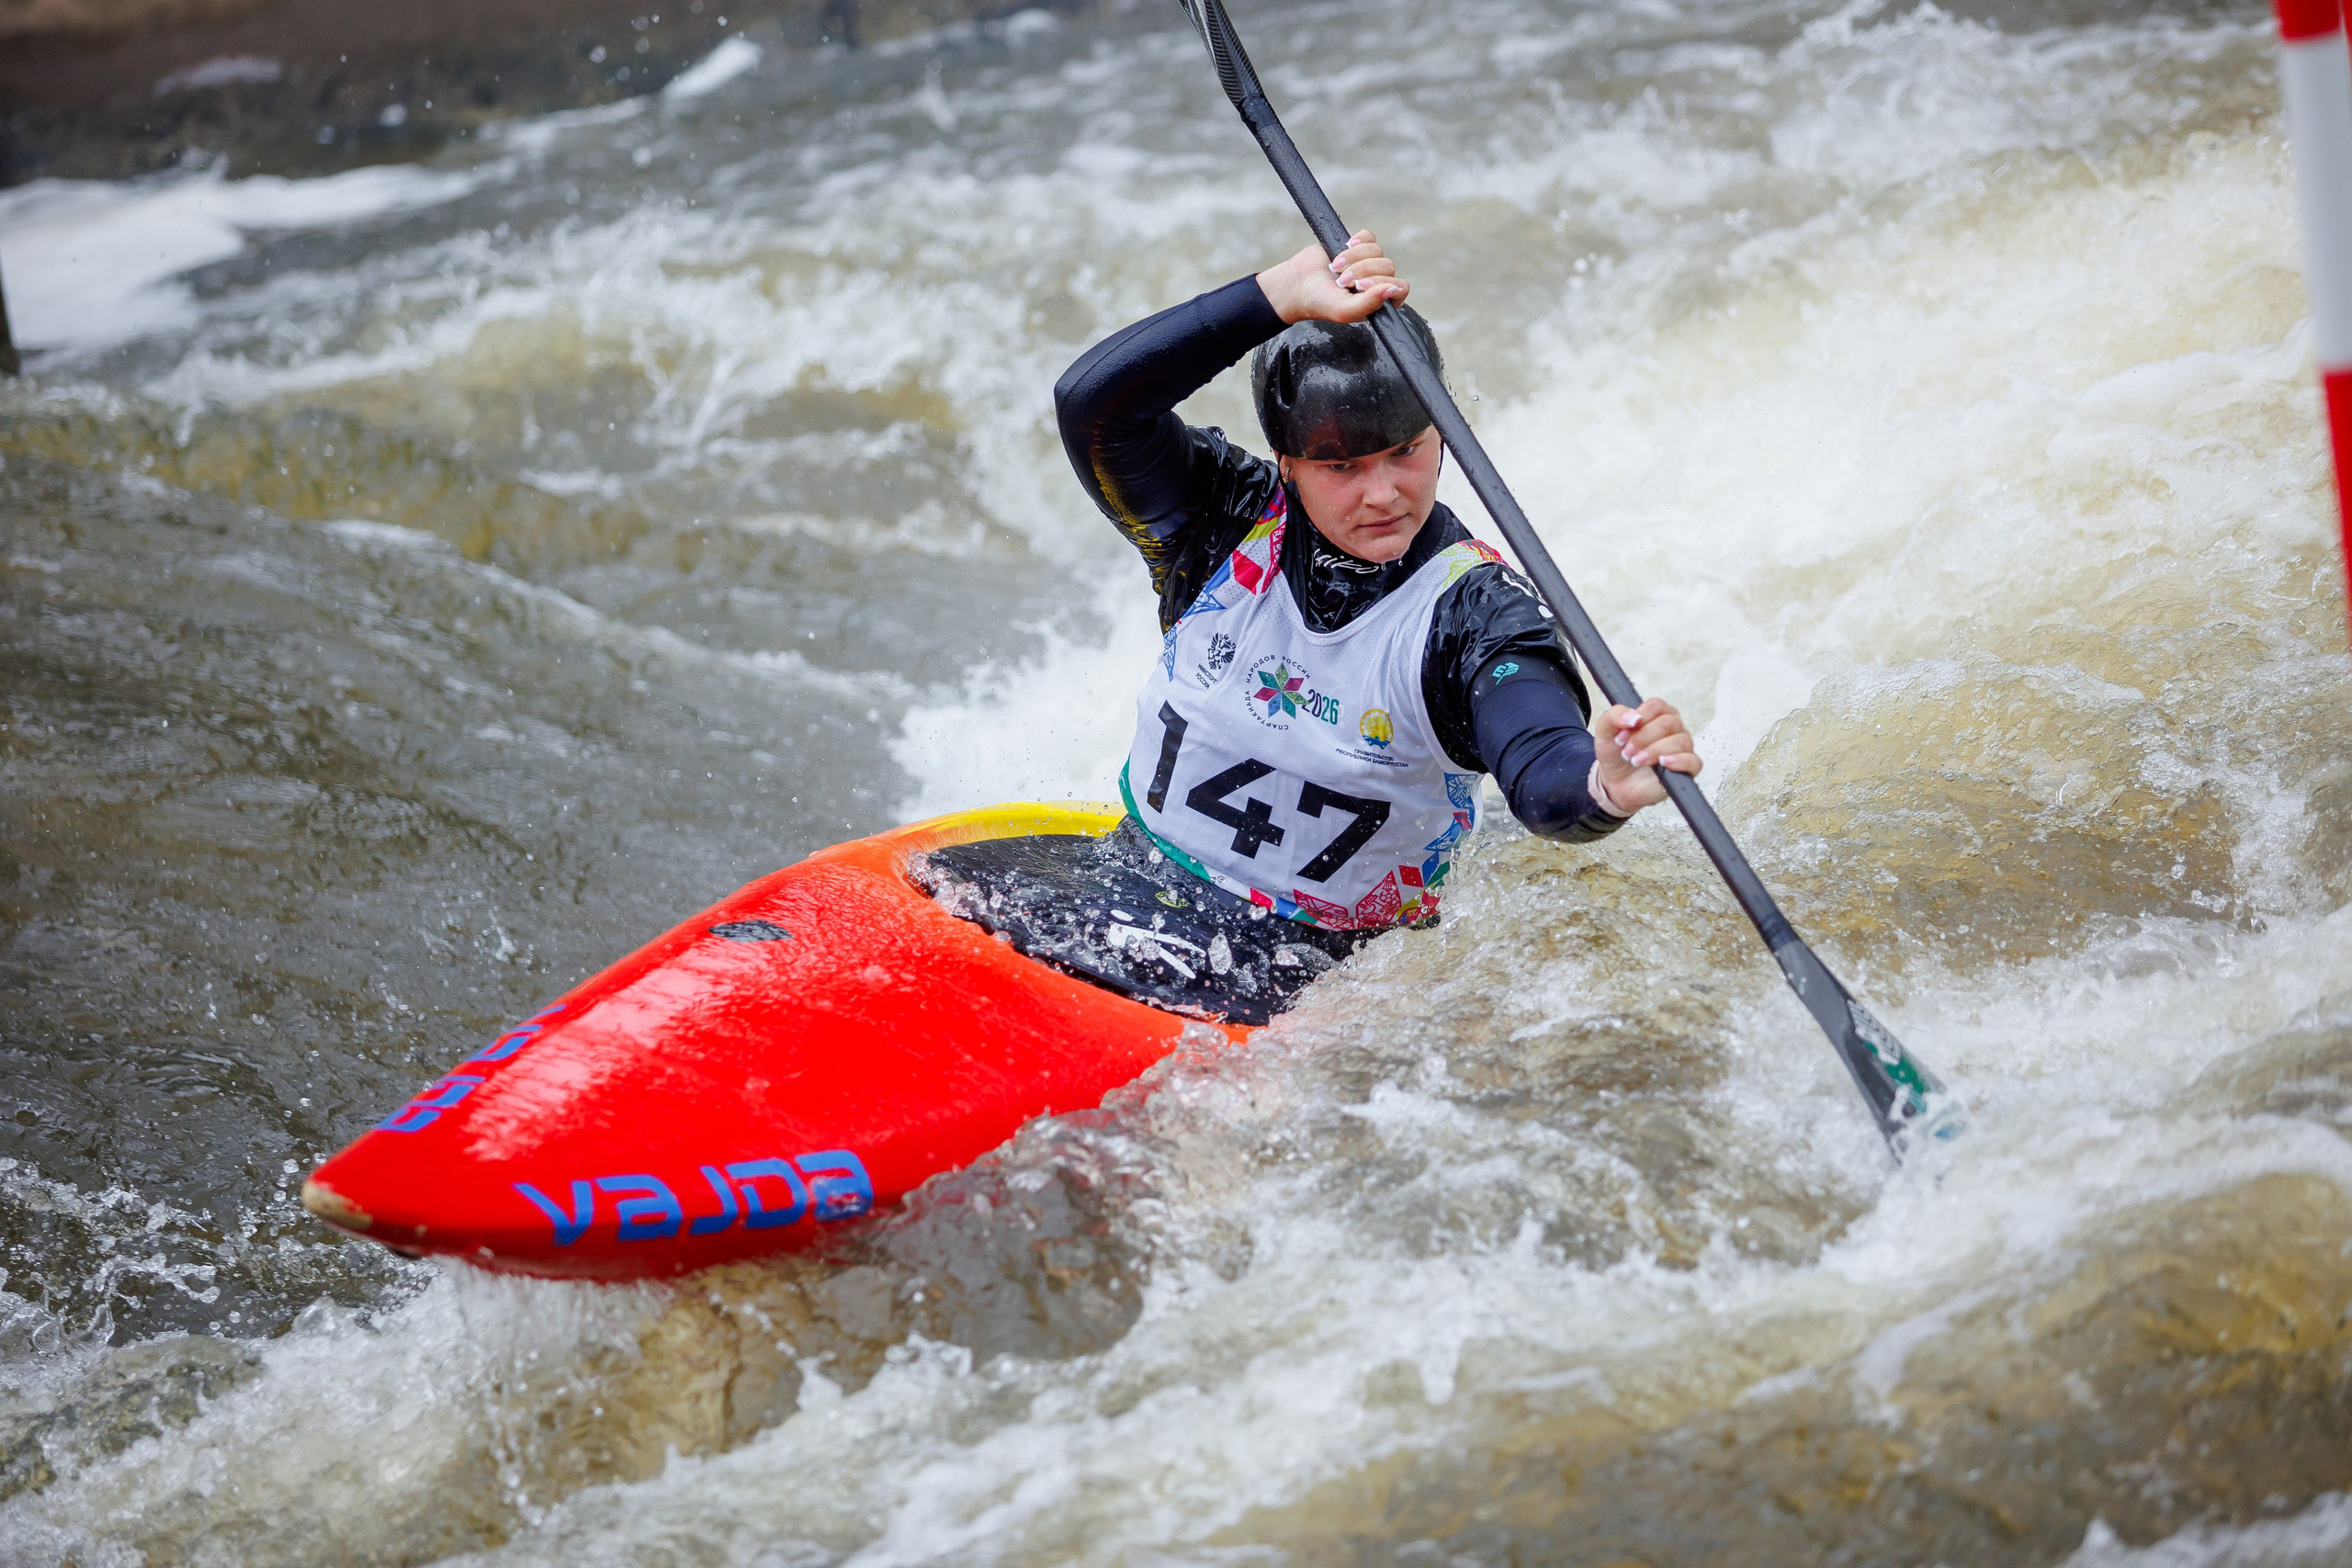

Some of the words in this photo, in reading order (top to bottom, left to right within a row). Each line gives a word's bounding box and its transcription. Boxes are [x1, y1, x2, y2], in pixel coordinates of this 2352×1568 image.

[1246, 654, 1276, 684] НАРОДОВ
[1282, 655, 1311, 680] РОССИИ
[1244, 690, 1289, 730] СПАРТАКИАДА
[1301, 688, 1340, 726] 2026
[1336, 748, 1372, 762] РЕСПУБЛИКИ
[1147, 699, 1392, 884] 147
